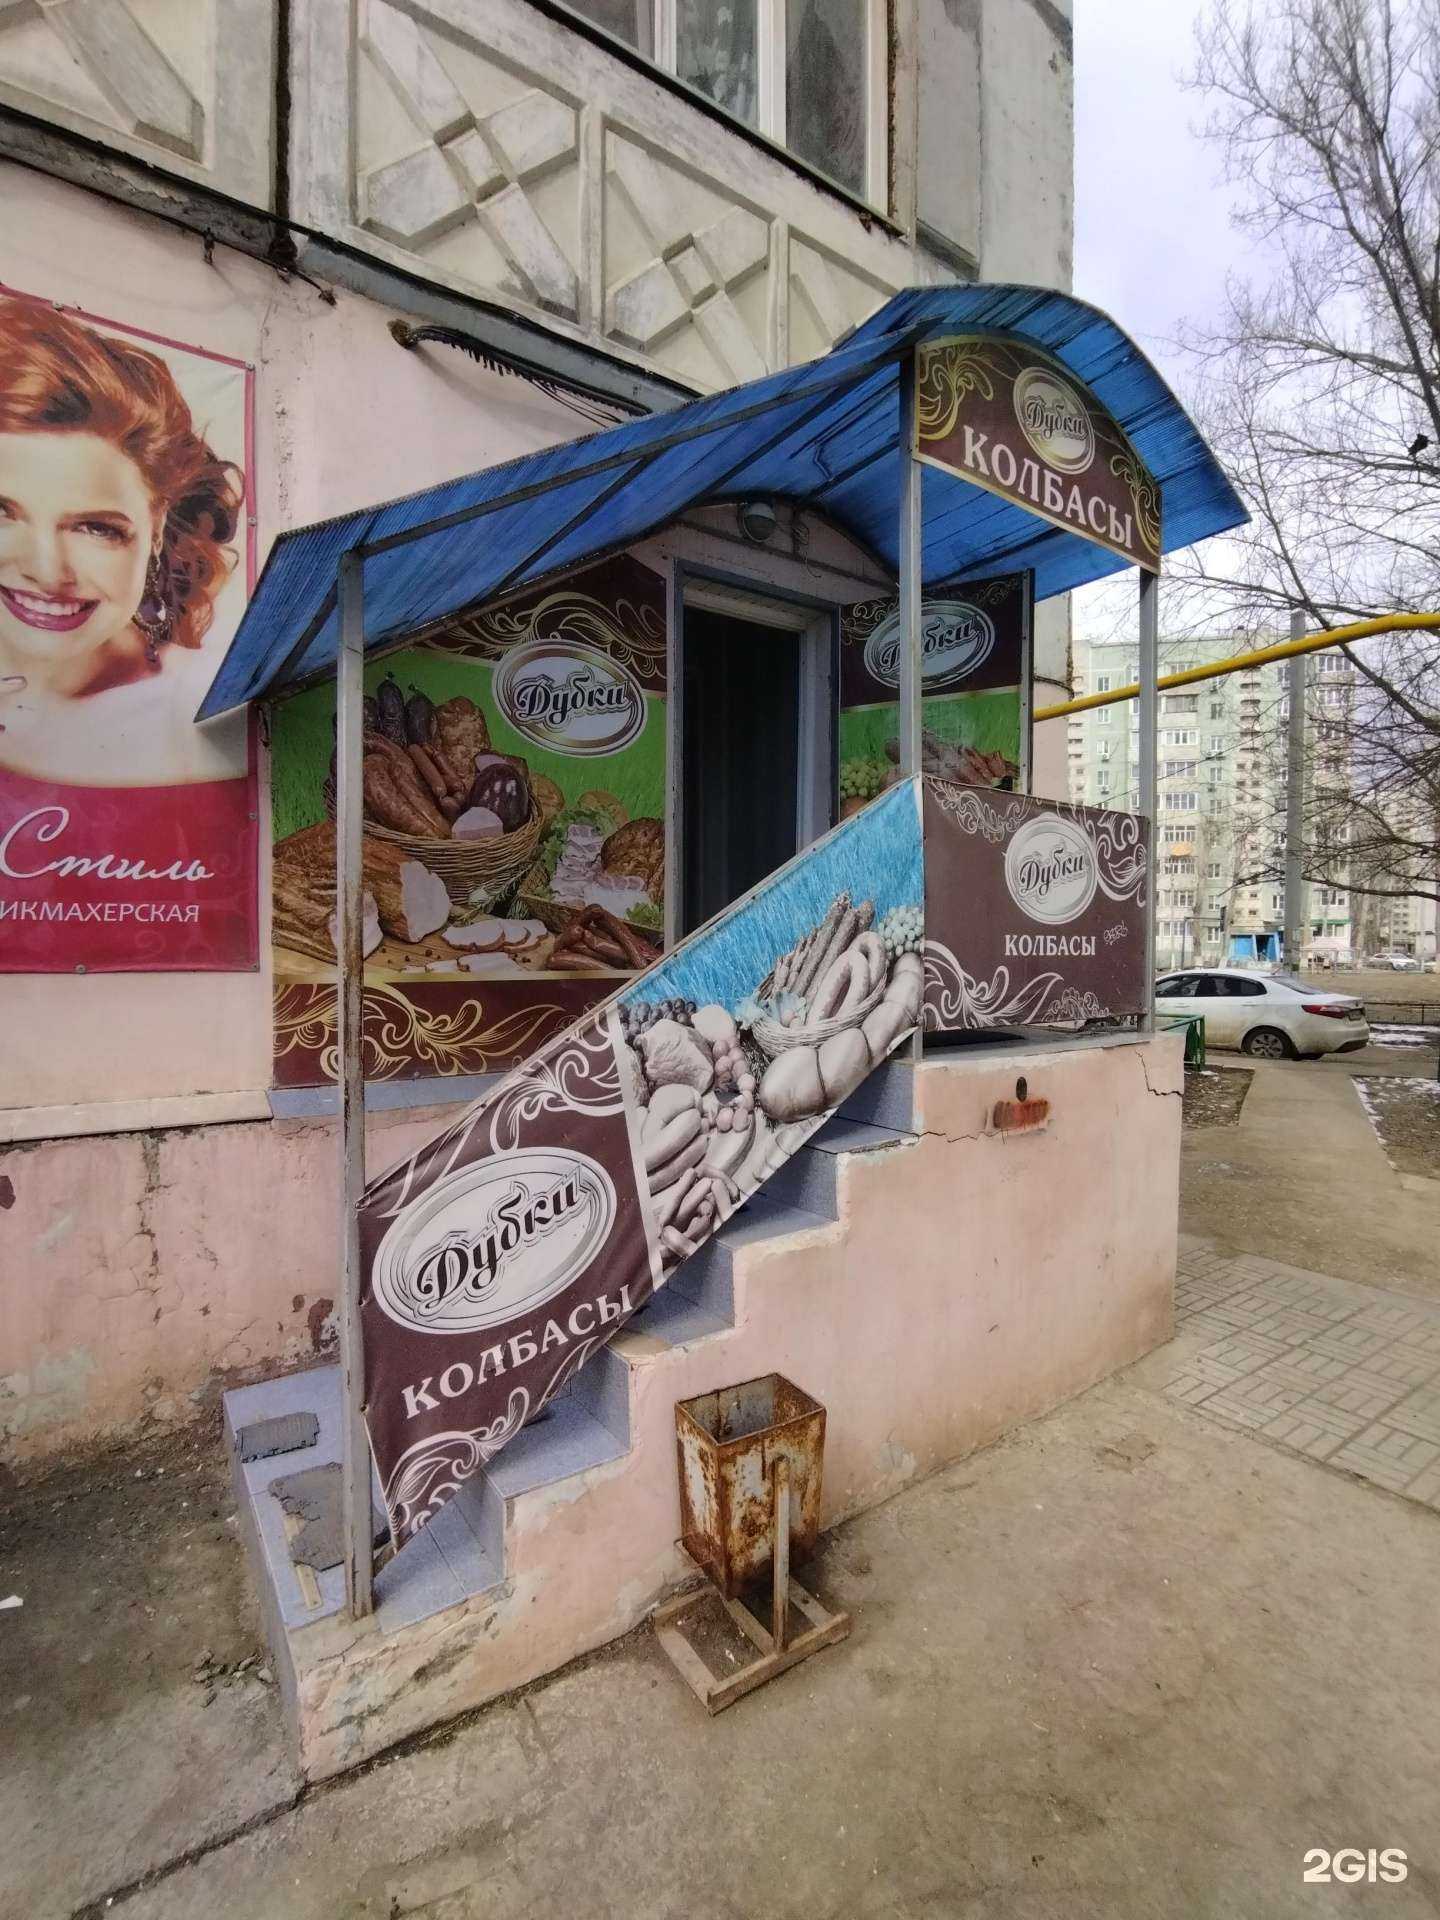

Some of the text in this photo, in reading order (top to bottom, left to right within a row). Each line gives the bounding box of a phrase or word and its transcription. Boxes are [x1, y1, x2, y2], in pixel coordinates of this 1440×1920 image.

[1025, 395, 1085, 438] Дубки
[963, 425, 1133, 549] КОЛБАСЫ
[881, 620, 972, 672] Дбки
[516, 675, 626, 725] Дубки
[0, 806, 215, 880] Стиль
[1019, 849, 1085, 897] Дубки
[1004, 934, 1097, 957] КОЛБАСЫ
[416, 1181, 578, 1309] Дубки
[401, 1284, 634, 1420] КОЛБАСЫ
